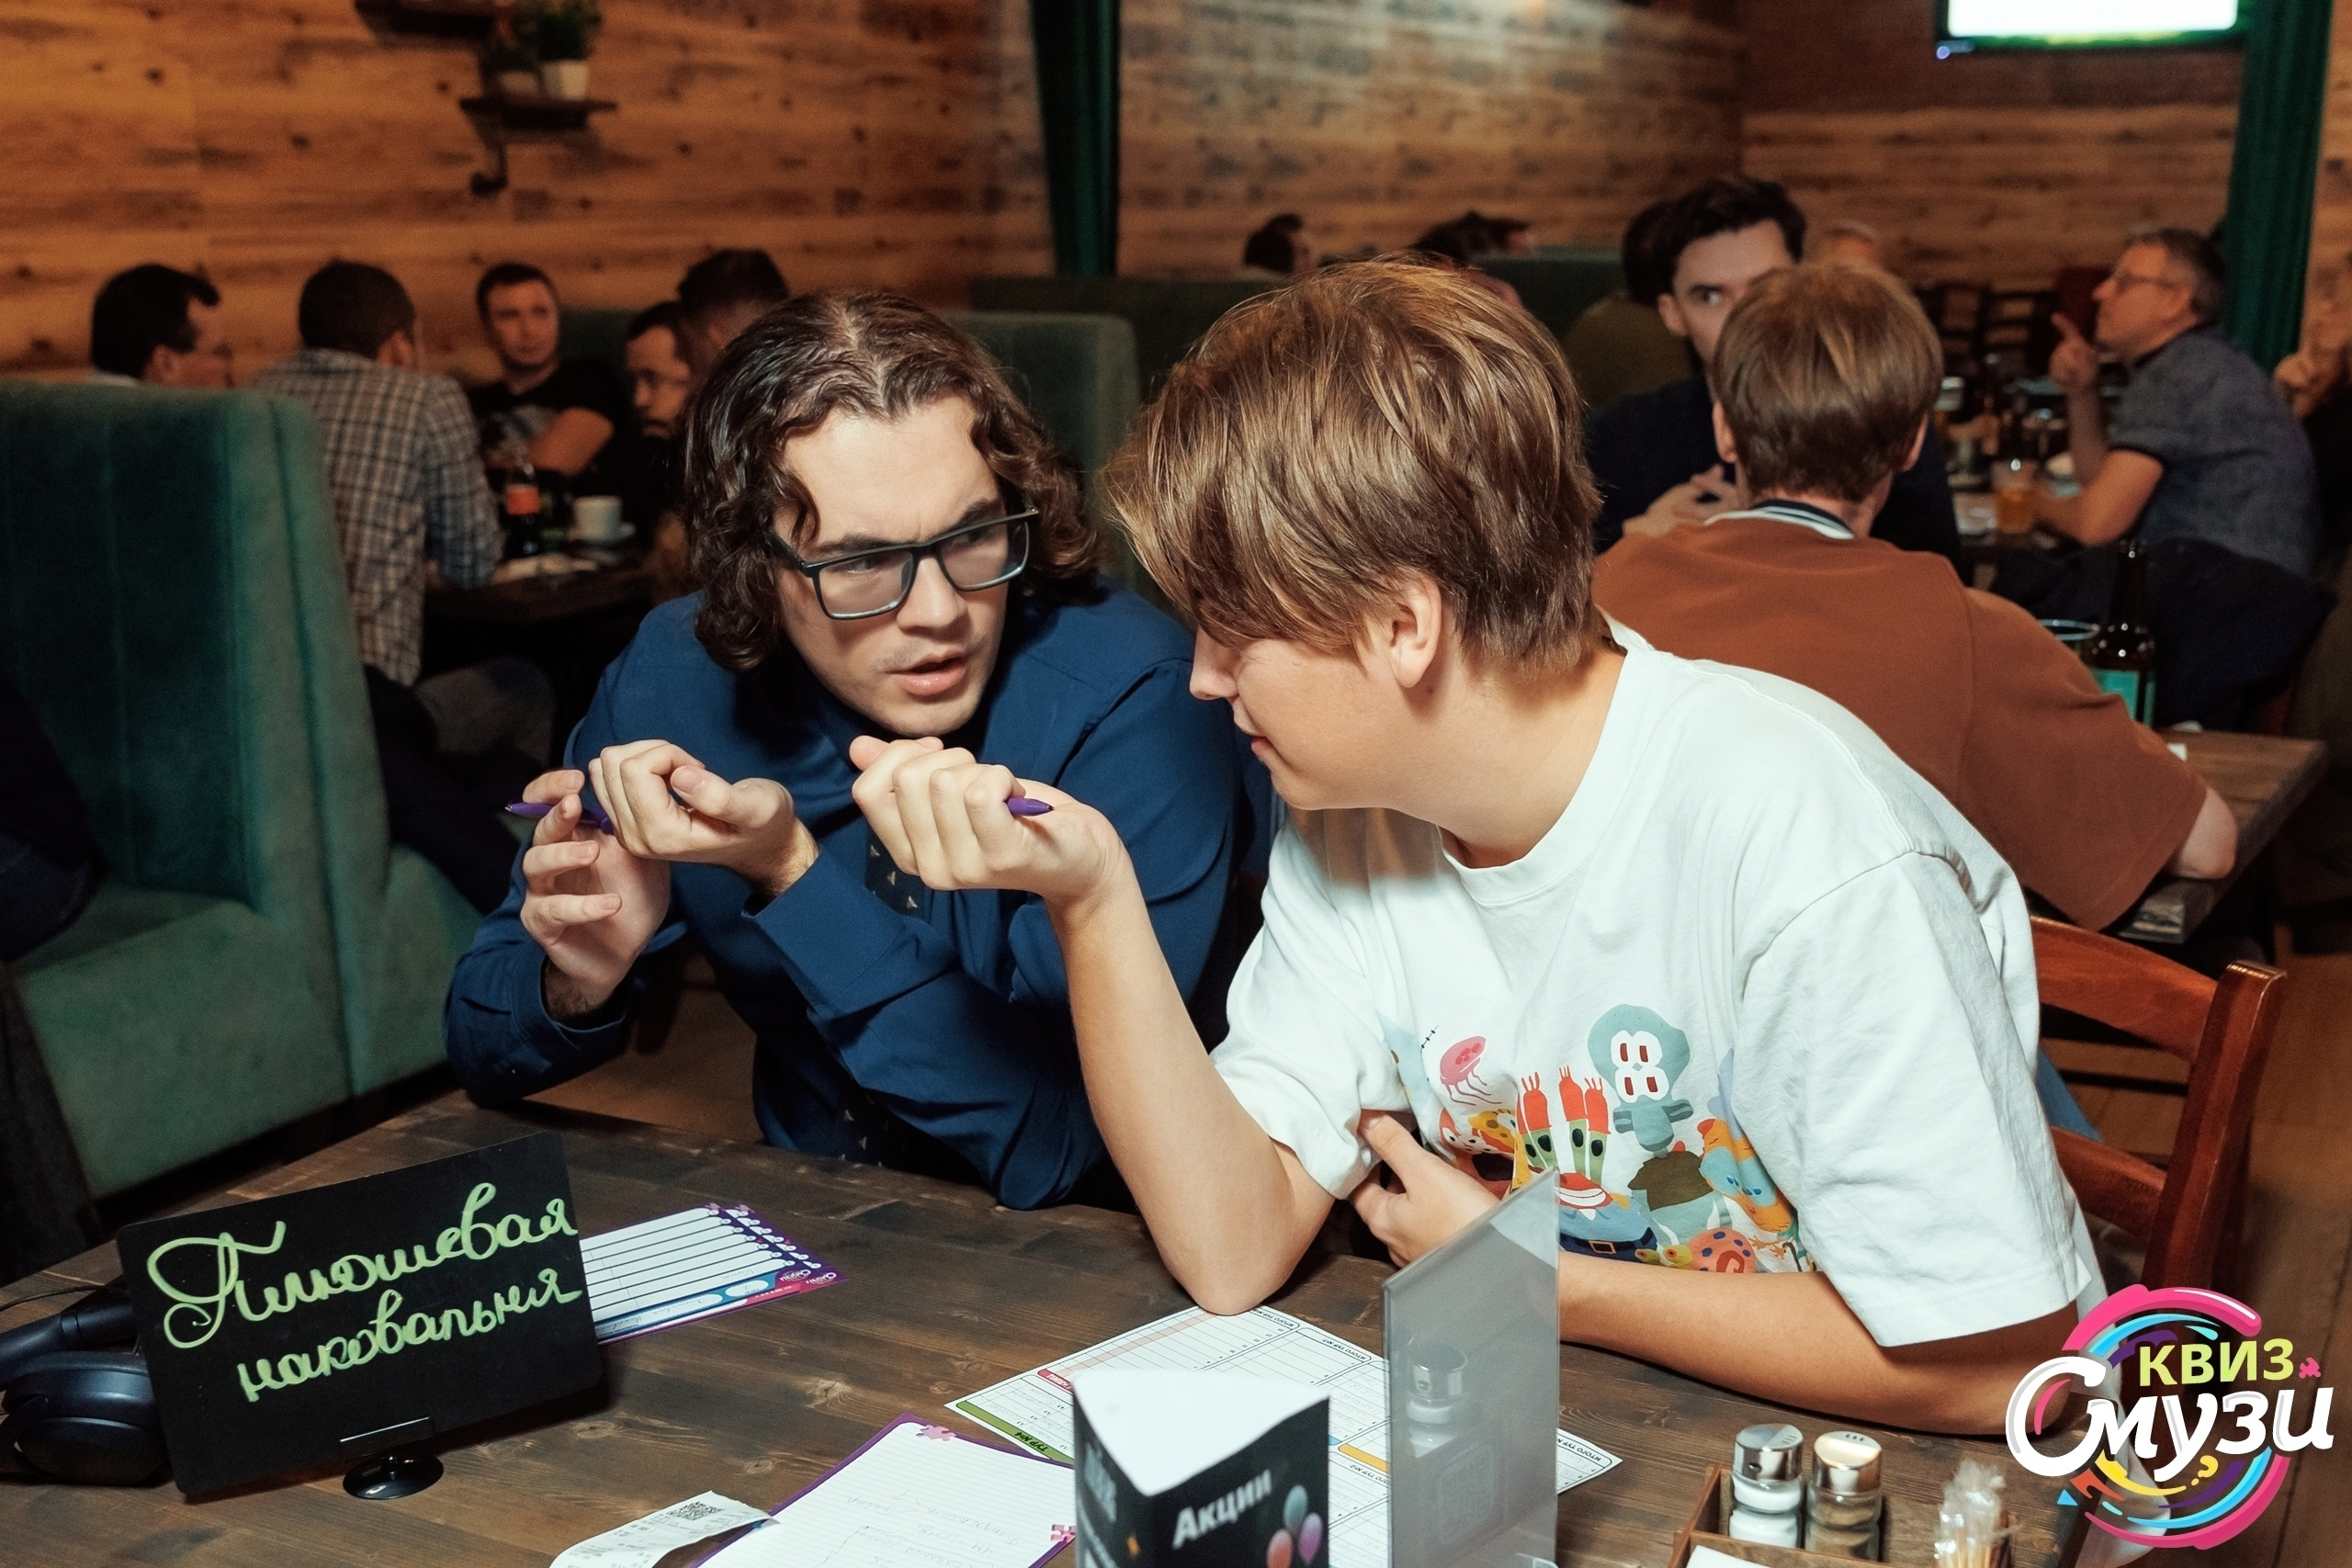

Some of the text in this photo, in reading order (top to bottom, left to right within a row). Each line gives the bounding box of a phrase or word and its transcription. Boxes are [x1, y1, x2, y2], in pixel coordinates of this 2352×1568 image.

[237, 1268, 583, 1403] наковальня
[1013, 1431, 1032, 1443] №4
[1029, 1438, 1048, 1452] ТУР
[1562, 1440, 1577, 1450] ТУР
[1577, 1448, 1602, 1462] ИТОГО
[1171, 1468, 1273, 1551] Акции
